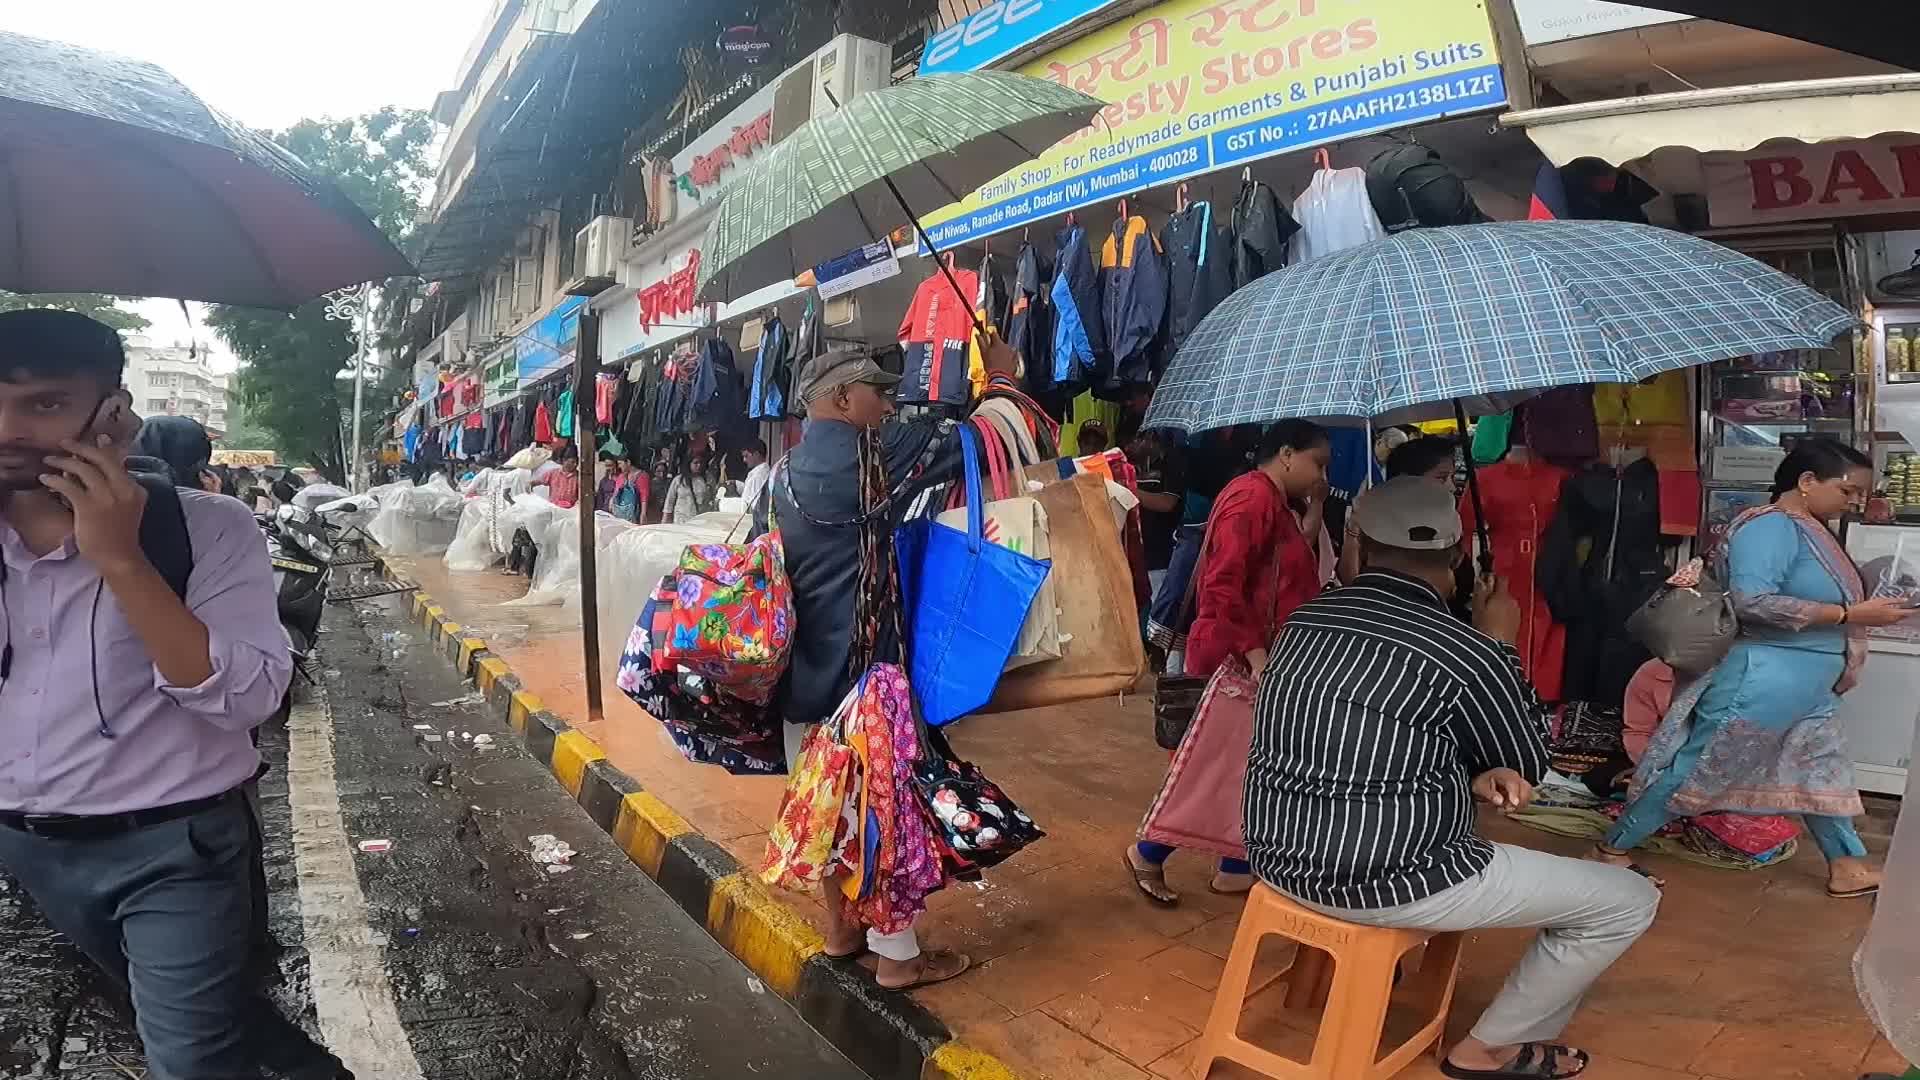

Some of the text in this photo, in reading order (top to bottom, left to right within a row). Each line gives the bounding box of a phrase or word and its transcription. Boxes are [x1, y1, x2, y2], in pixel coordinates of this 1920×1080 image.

[1201, 18, 1378, 95] Stores
[981, 178, 1017, 200] Family
[1021, 167, 1052, 187] Shop
[1064, 154, 1086, 174] For
[1090, 122, 1182, 163] Readymade
[1187, 91, 1283, 131] Garments
[1289, 82, 1306, 102] &
[1315, 54, 1406, 97] Punjabi
[1414, 41, 1484, 71] Suits
[1226, 130, 1256, 151] GST
[1260, 125, 1284, 144] No
[972, 211, 1004, 227] Ranade
[1005, 199, 1032, 216] Road,
[1033, 190, 1064, 209] Dadar
[1090, 163, 1139, 192] Mumbai
[1149, 146, 1198, 173] 400028
